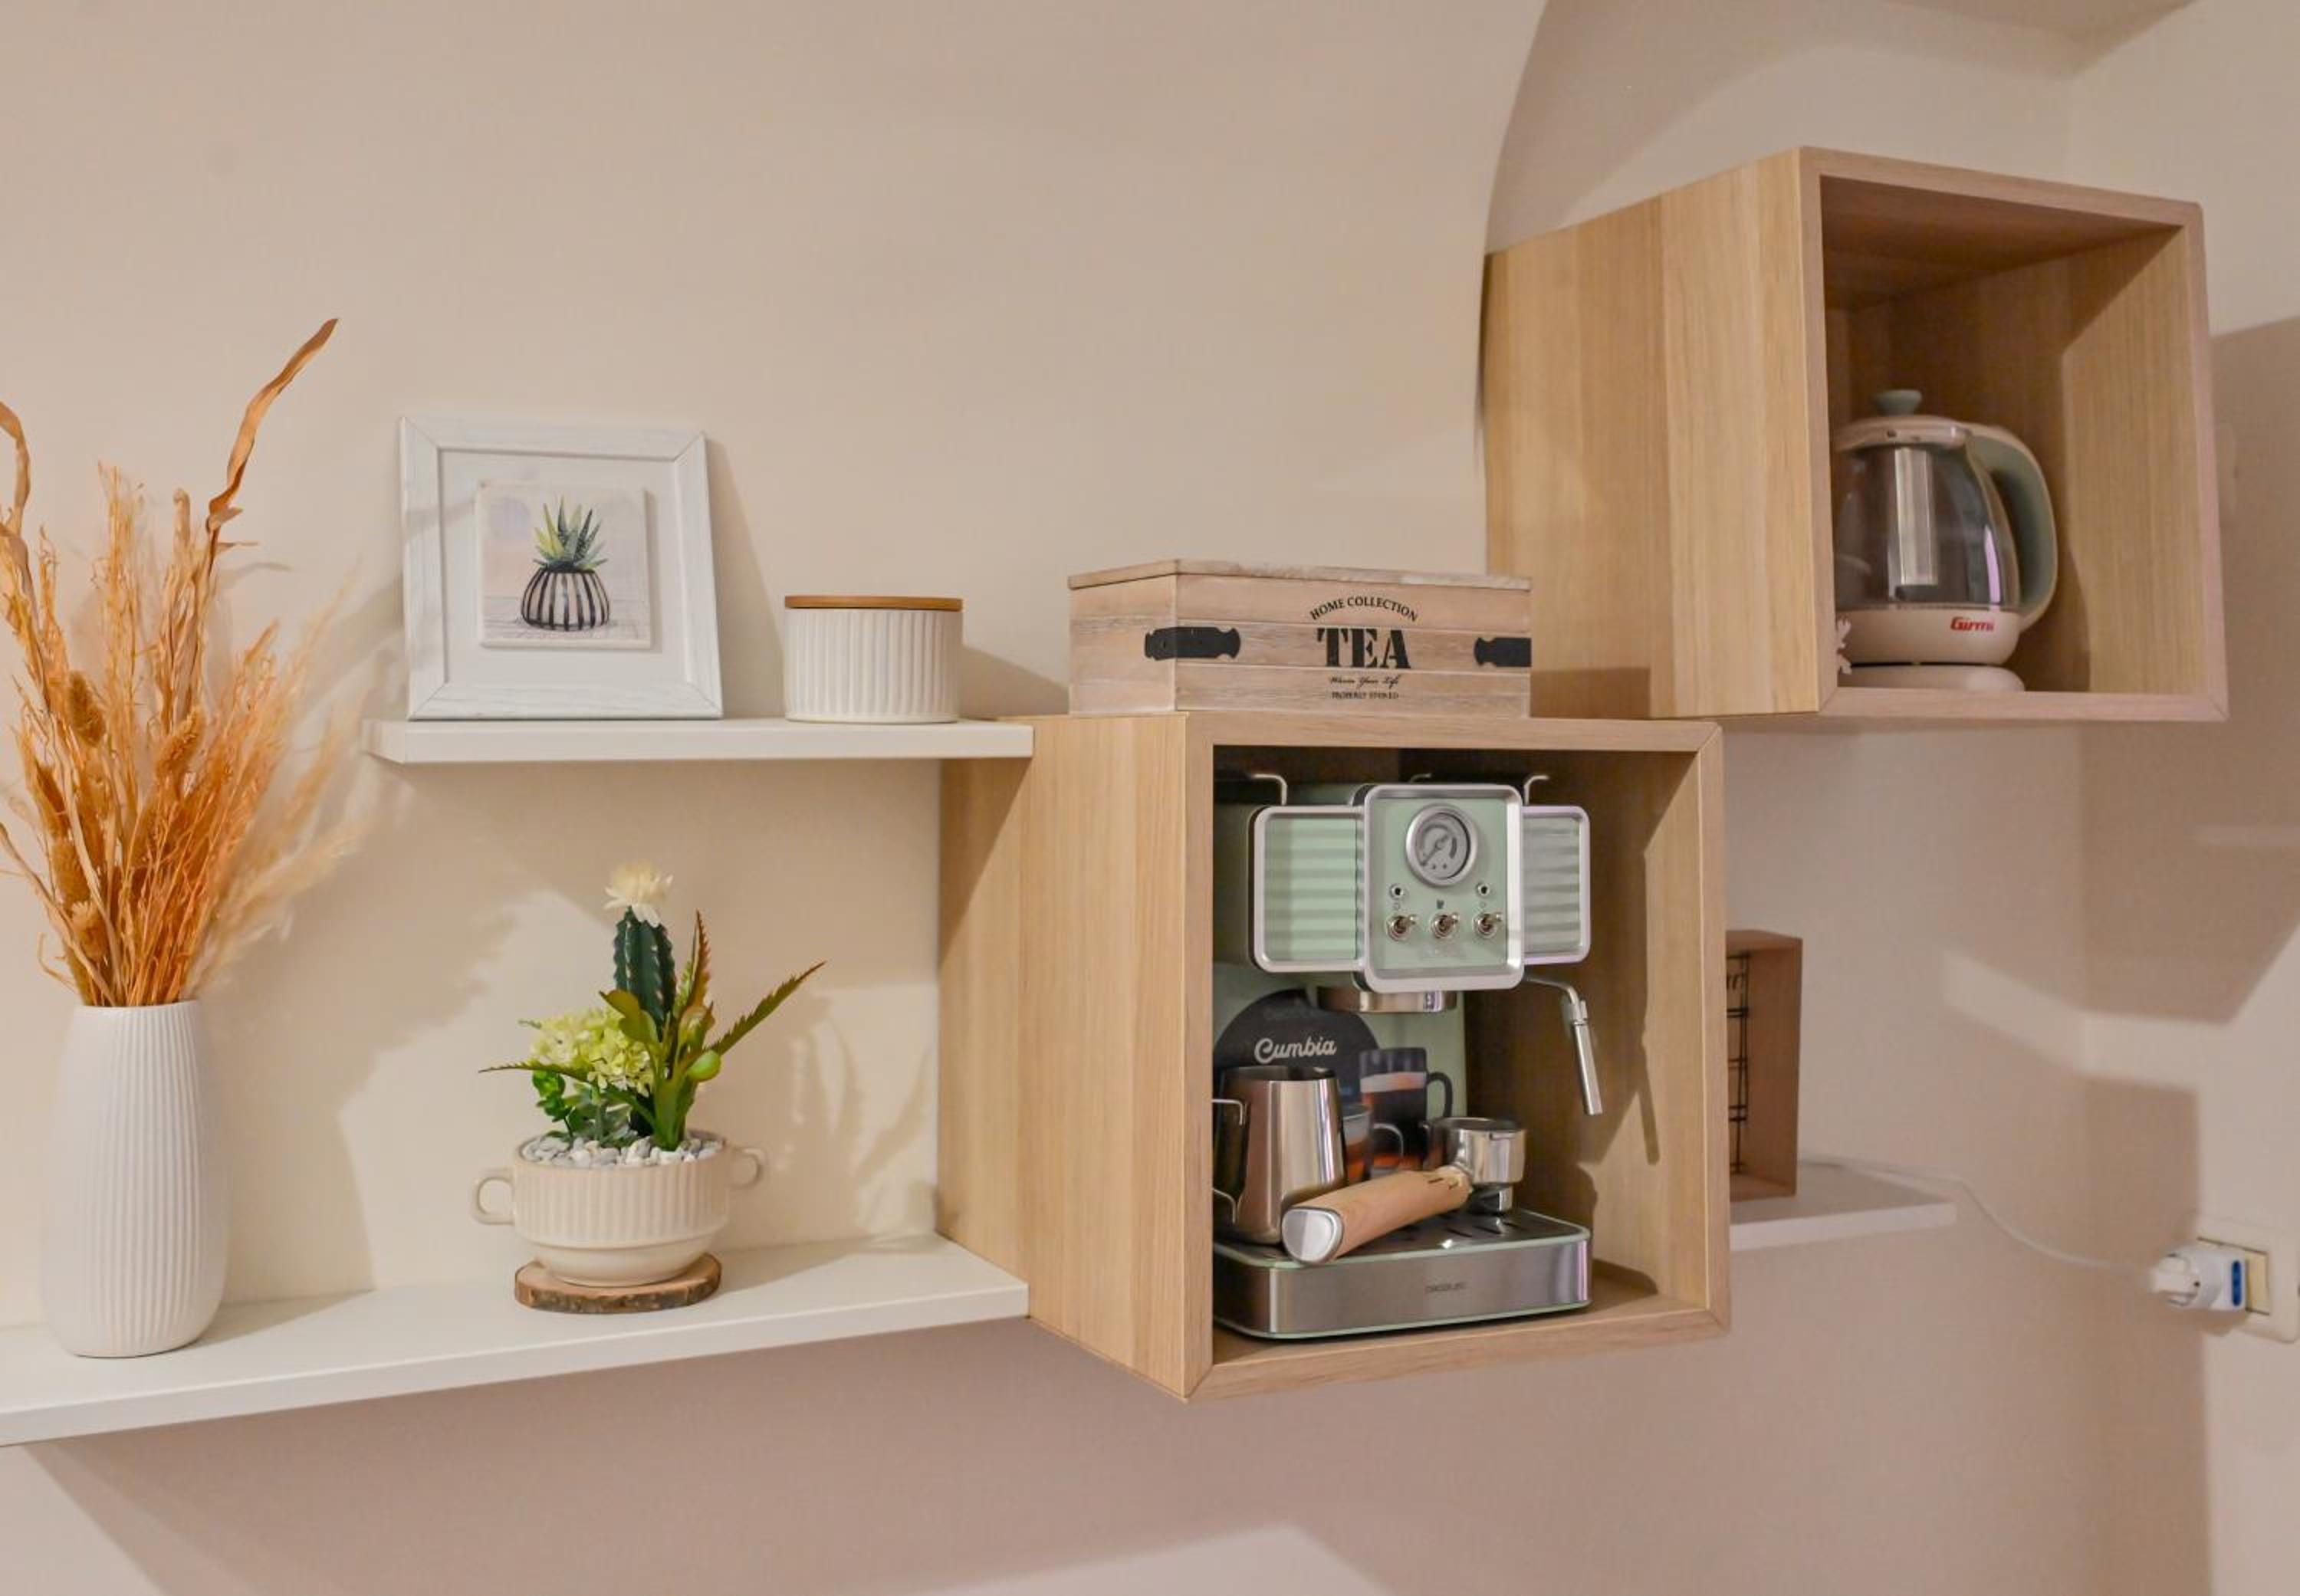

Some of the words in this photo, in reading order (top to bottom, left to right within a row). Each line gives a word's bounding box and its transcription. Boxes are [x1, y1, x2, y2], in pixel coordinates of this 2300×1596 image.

[1309, 598, 1346, 620] HOME
[1347, 596, 1418, 622] COLLECTION
[1316, 627, 1411, 669] TEA
[1254, 1036, 1338, 1065] Cumbia
